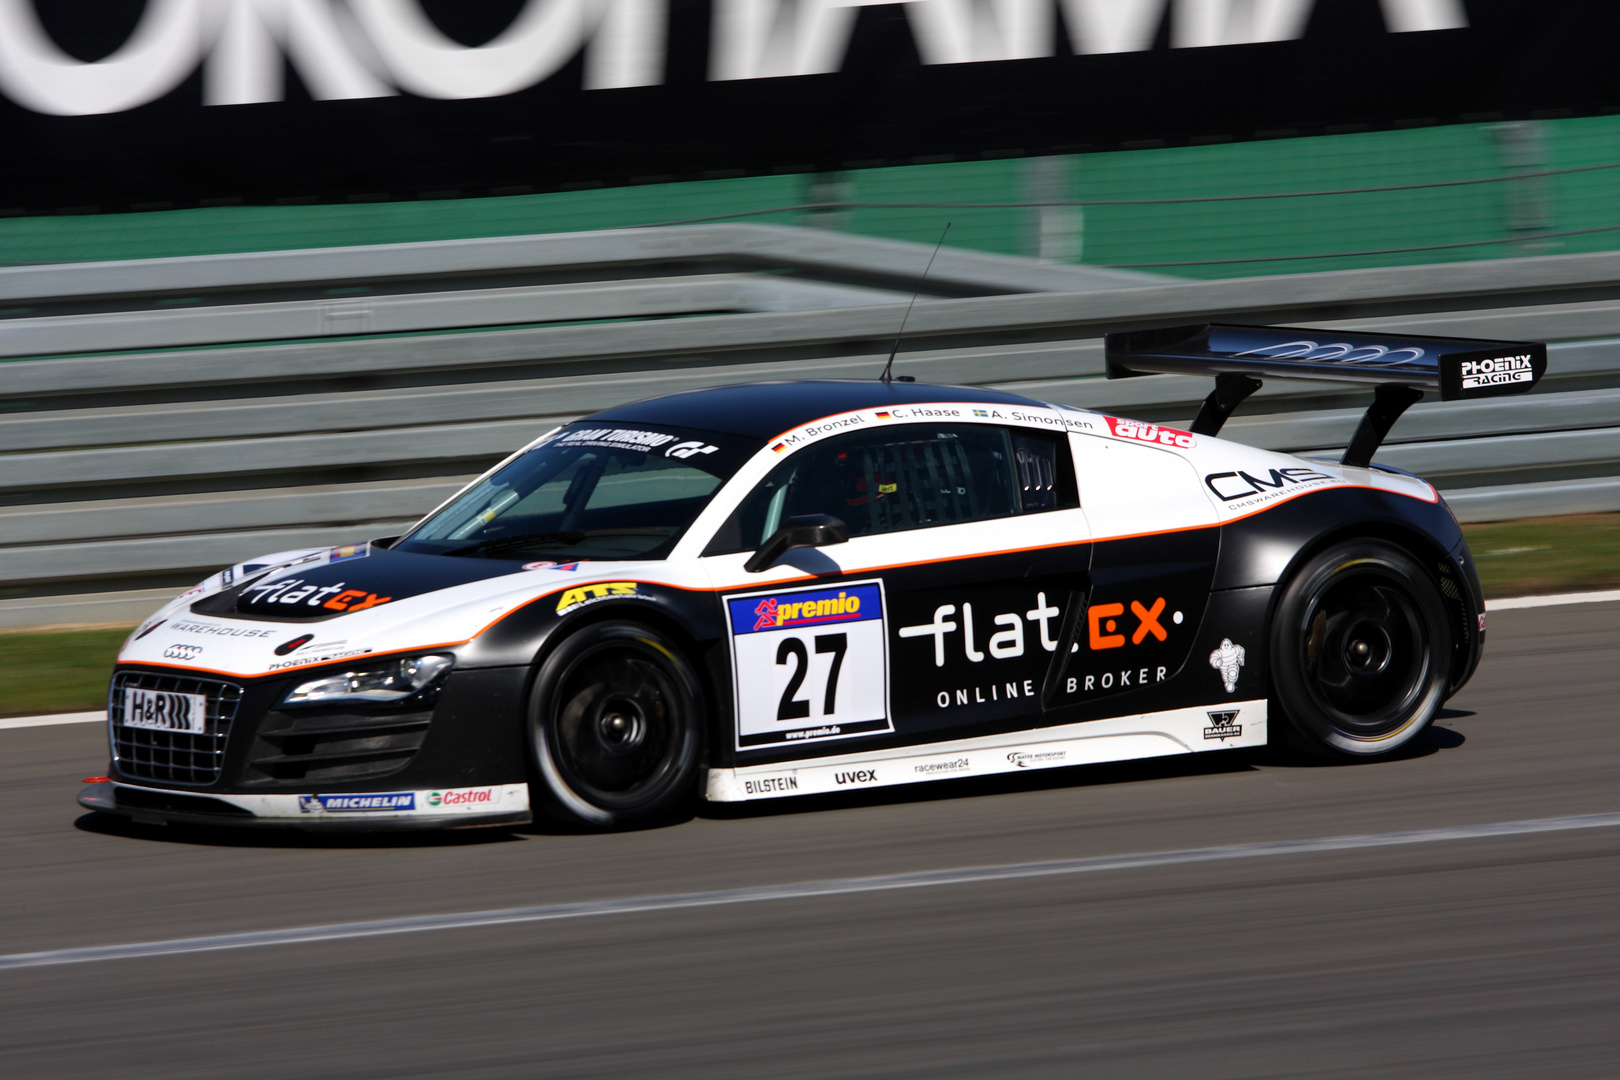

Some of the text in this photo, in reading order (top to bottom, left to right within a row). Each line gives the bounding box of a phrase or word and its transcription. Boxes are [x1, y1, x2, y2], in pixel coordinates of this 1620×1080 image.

[785, 408, 1093, 447] M. Bronzel C. Haase A. Simonsen
[1115, 424, 1197, 449] auto
[1205, 468, 1336, 501] CMS
[556, 582, 637, 612] ATS
[776, 592, 861, 626] premio
[170, 622, 278, 638] WAREHOUSE
[776, 632, 848, 721] 27
[937, 666, 1167, 708] ONLINE BROKER
[1204, 726, 1241, 735] BAUER
[914, 758, 969, 773] racewear24
[745, 776, 799, 794] BILSTEIN
[835, 769, 878, 784] uvex
[326, 795, 412, 808] MICHELIN
[443, 789, 492, 805] Castrol
